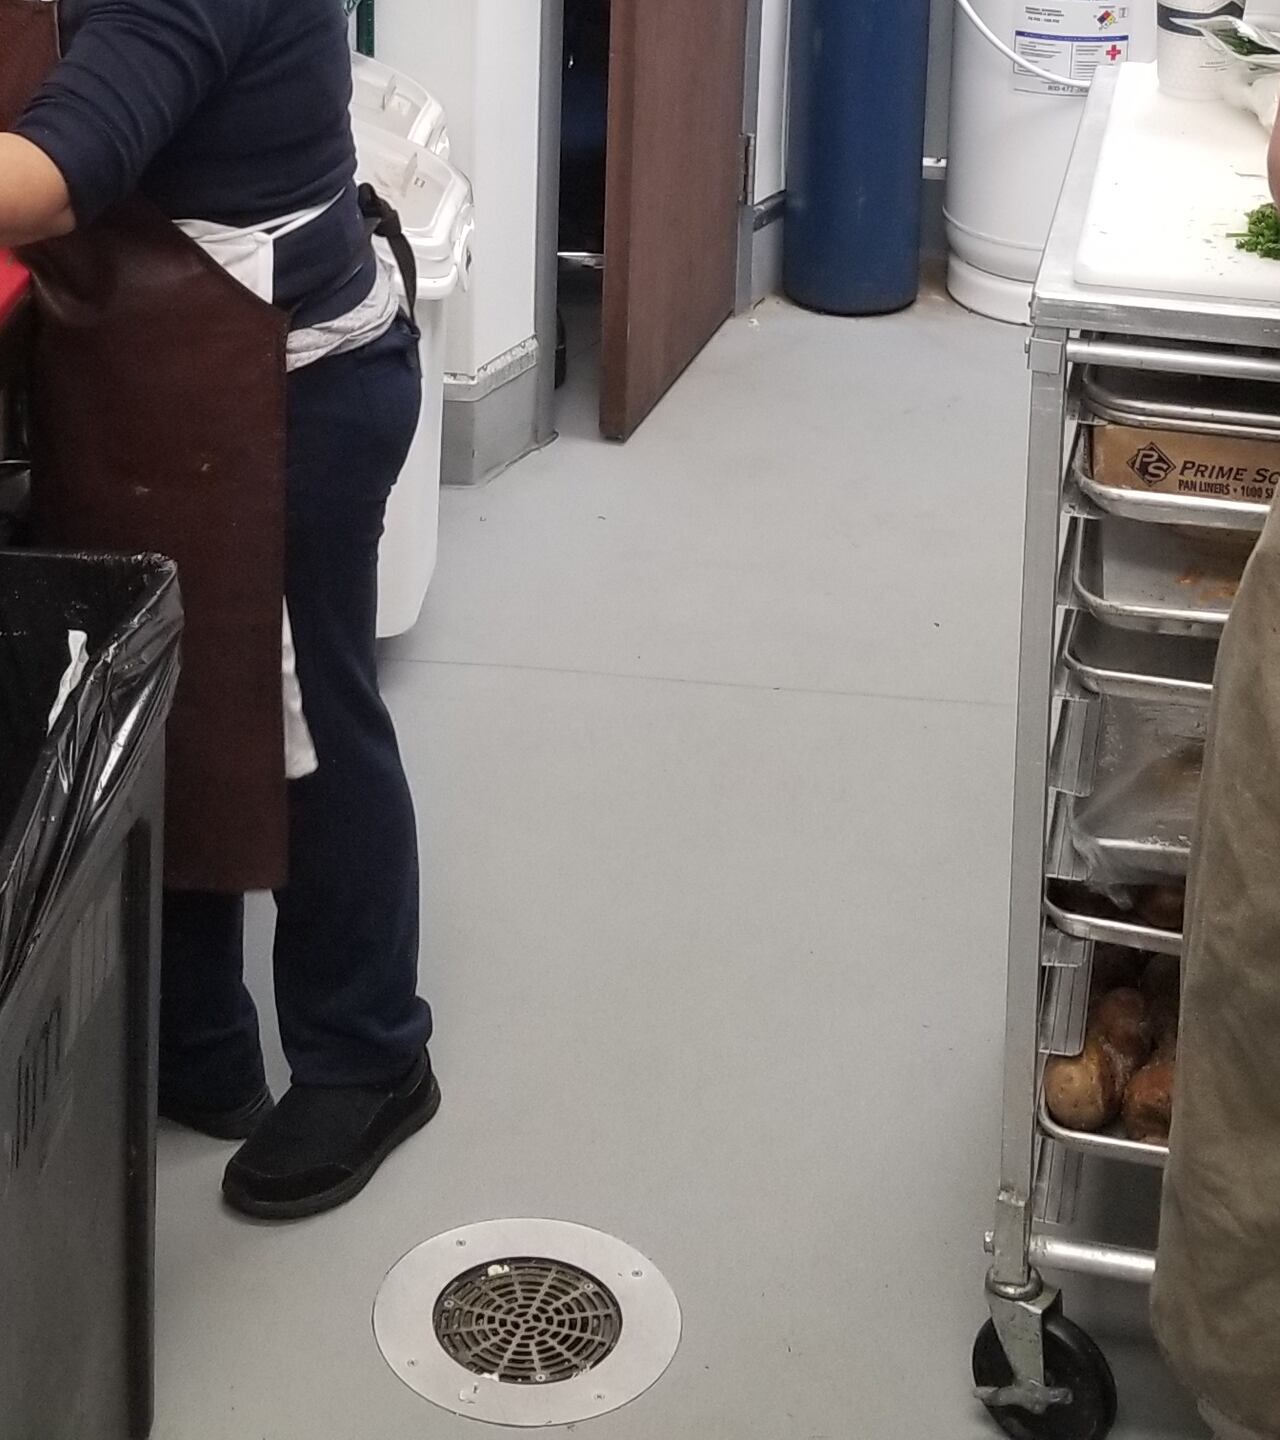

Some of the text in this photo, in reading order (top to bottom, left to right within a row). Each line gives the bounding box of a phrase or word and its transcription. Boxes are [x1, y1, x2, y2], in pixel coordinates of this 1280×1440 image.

[1178, 460, 1248, 482] PRIME
[1178, 479, 1197, 493] PAN
[1198, 480, 1230, 496] LINERS
[1241, 484, 1263, 499] 1000
